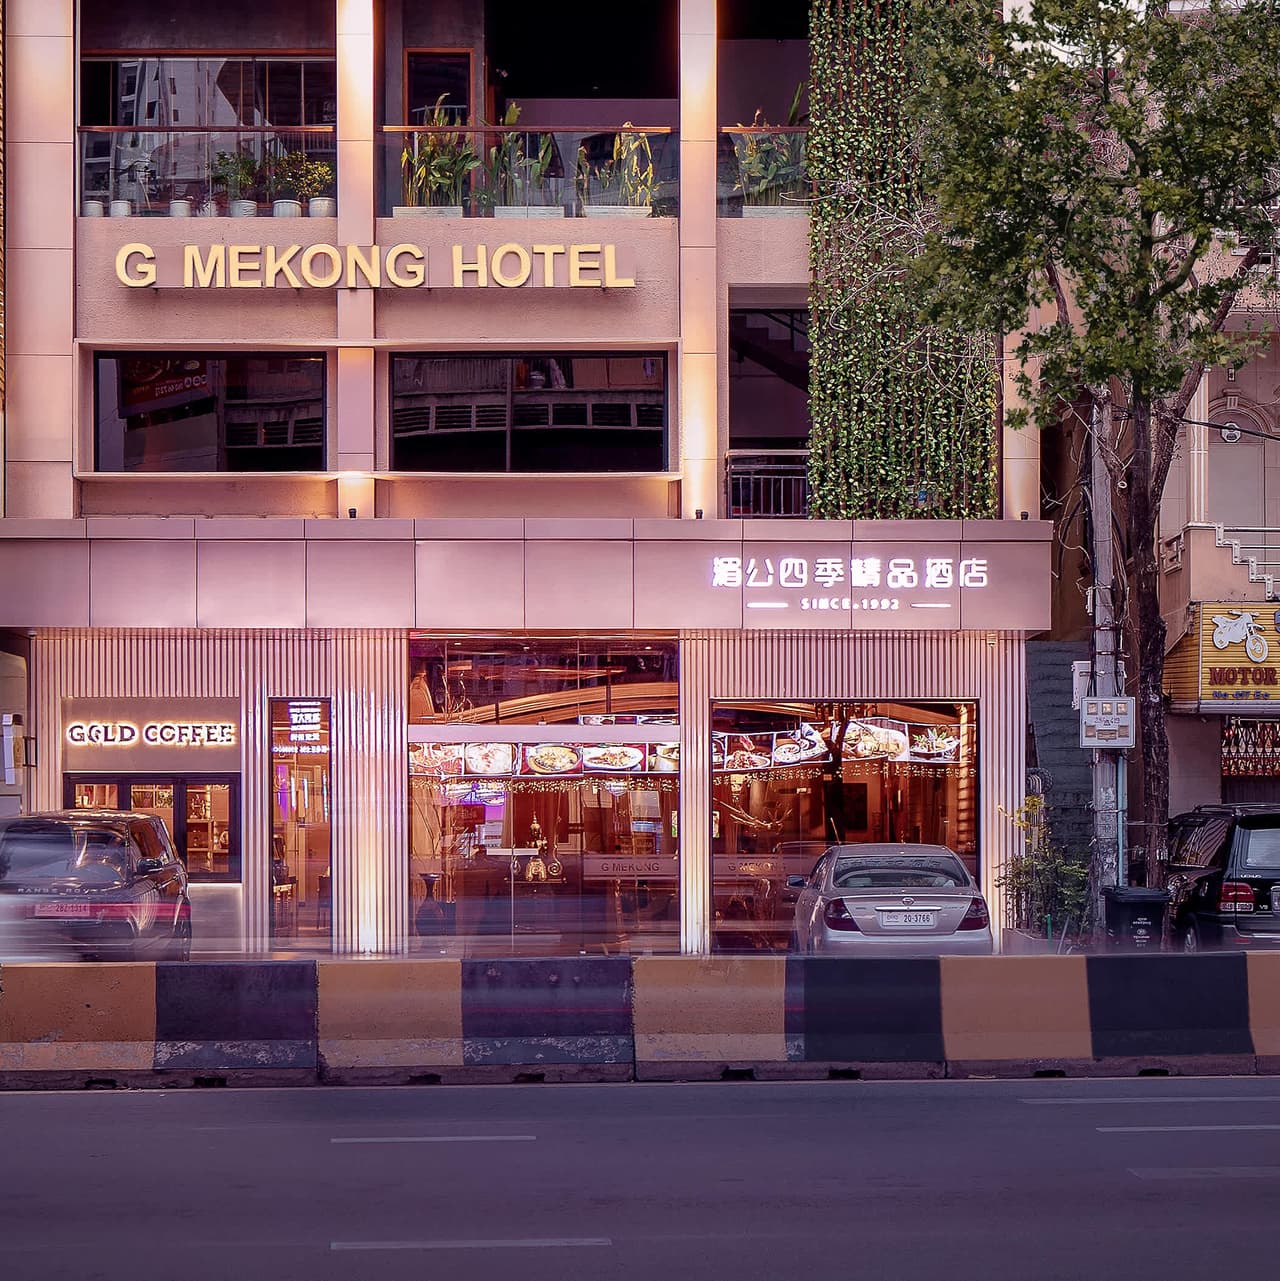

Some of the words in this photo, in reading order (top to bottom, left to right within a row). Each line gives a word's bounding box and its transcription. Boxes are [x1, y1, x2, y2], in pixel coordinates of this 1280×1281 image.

[115, 242, 157, 288] G
[182, 242, 426, 289] MEKONG
[452, 242, 636, 288] HOTEL
[1209, 667, 1277, 685] MOTOR
[68, 723, 136, 743] GOLD
[144, 723, 234, 743] COFFEE
[601, 862, 609, 872] G
